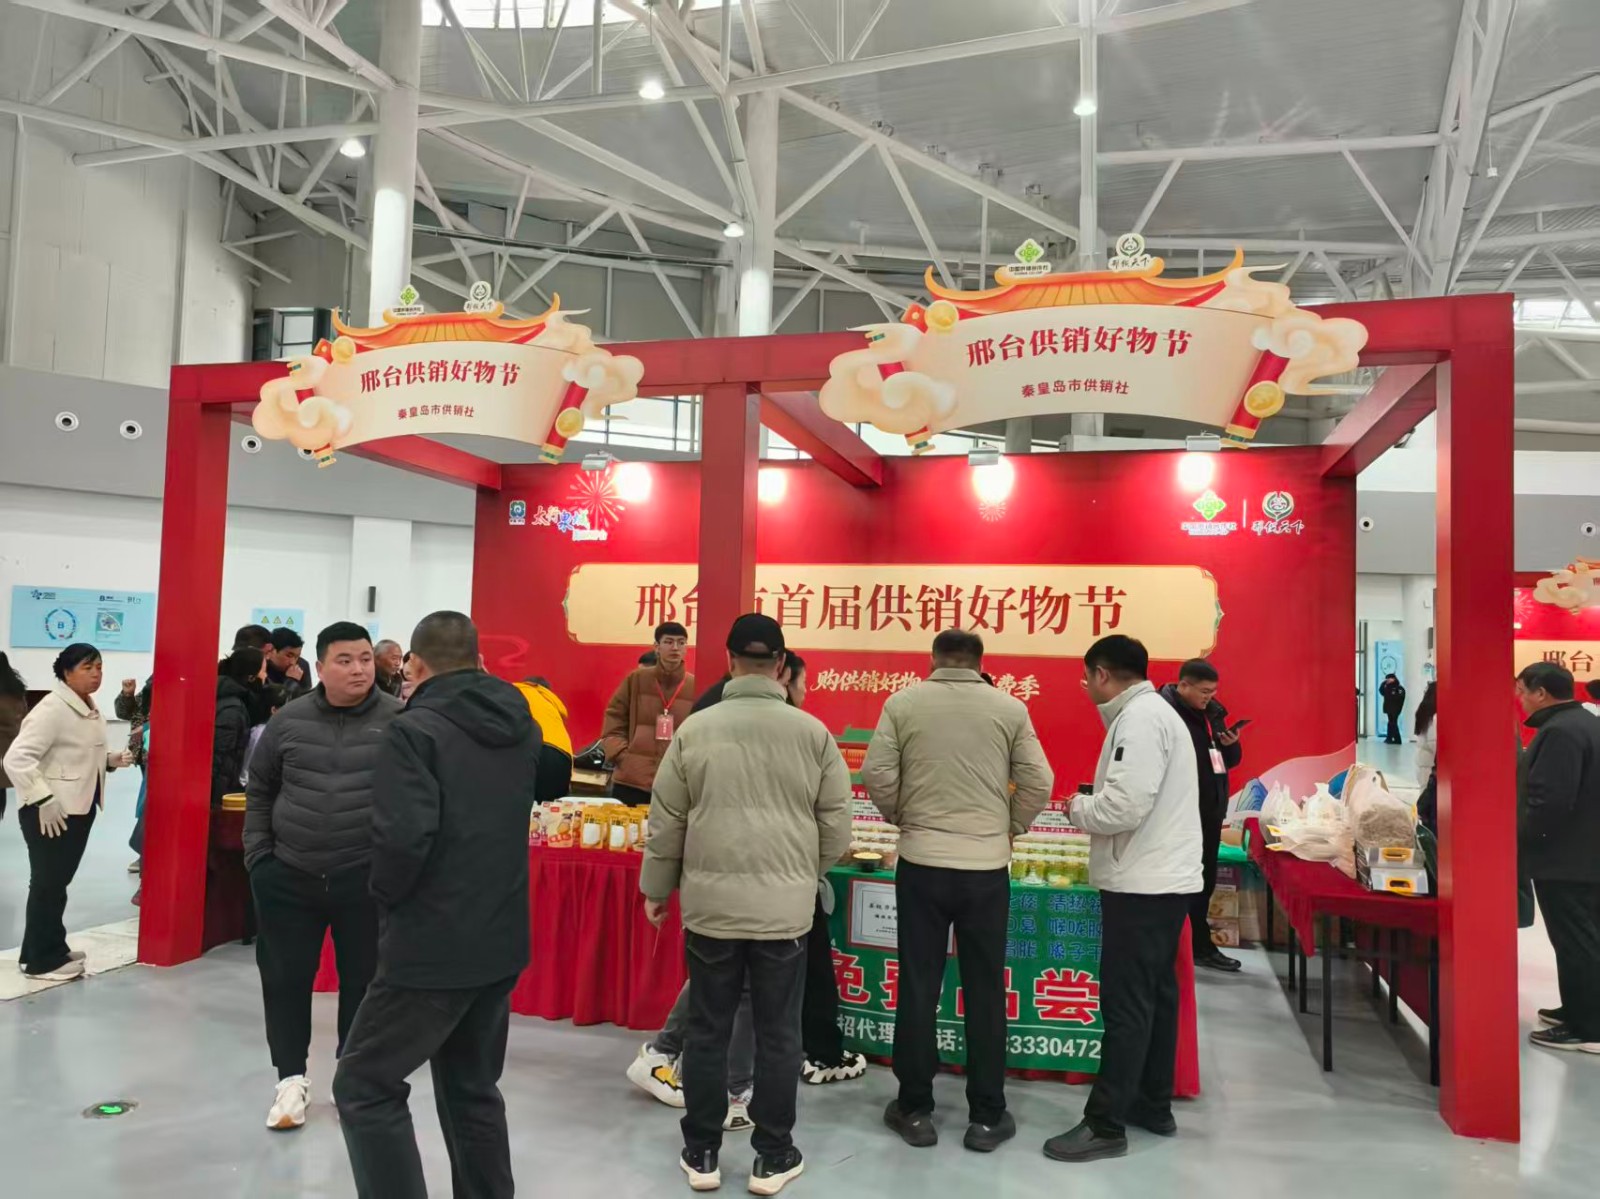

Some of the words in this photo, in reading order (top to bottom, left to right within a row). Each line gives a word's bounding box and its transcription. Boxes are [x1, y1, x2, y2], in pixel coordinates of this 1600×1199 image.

[967, 325, 1193, 368] 邢台供销好物节
[360, 359, 521, 394] 邢台供销好物节
[1020, 379, 1130, 398] 秦皇岛市供销社
[397, 404, 475, 420] 秦皇岛市供销社
